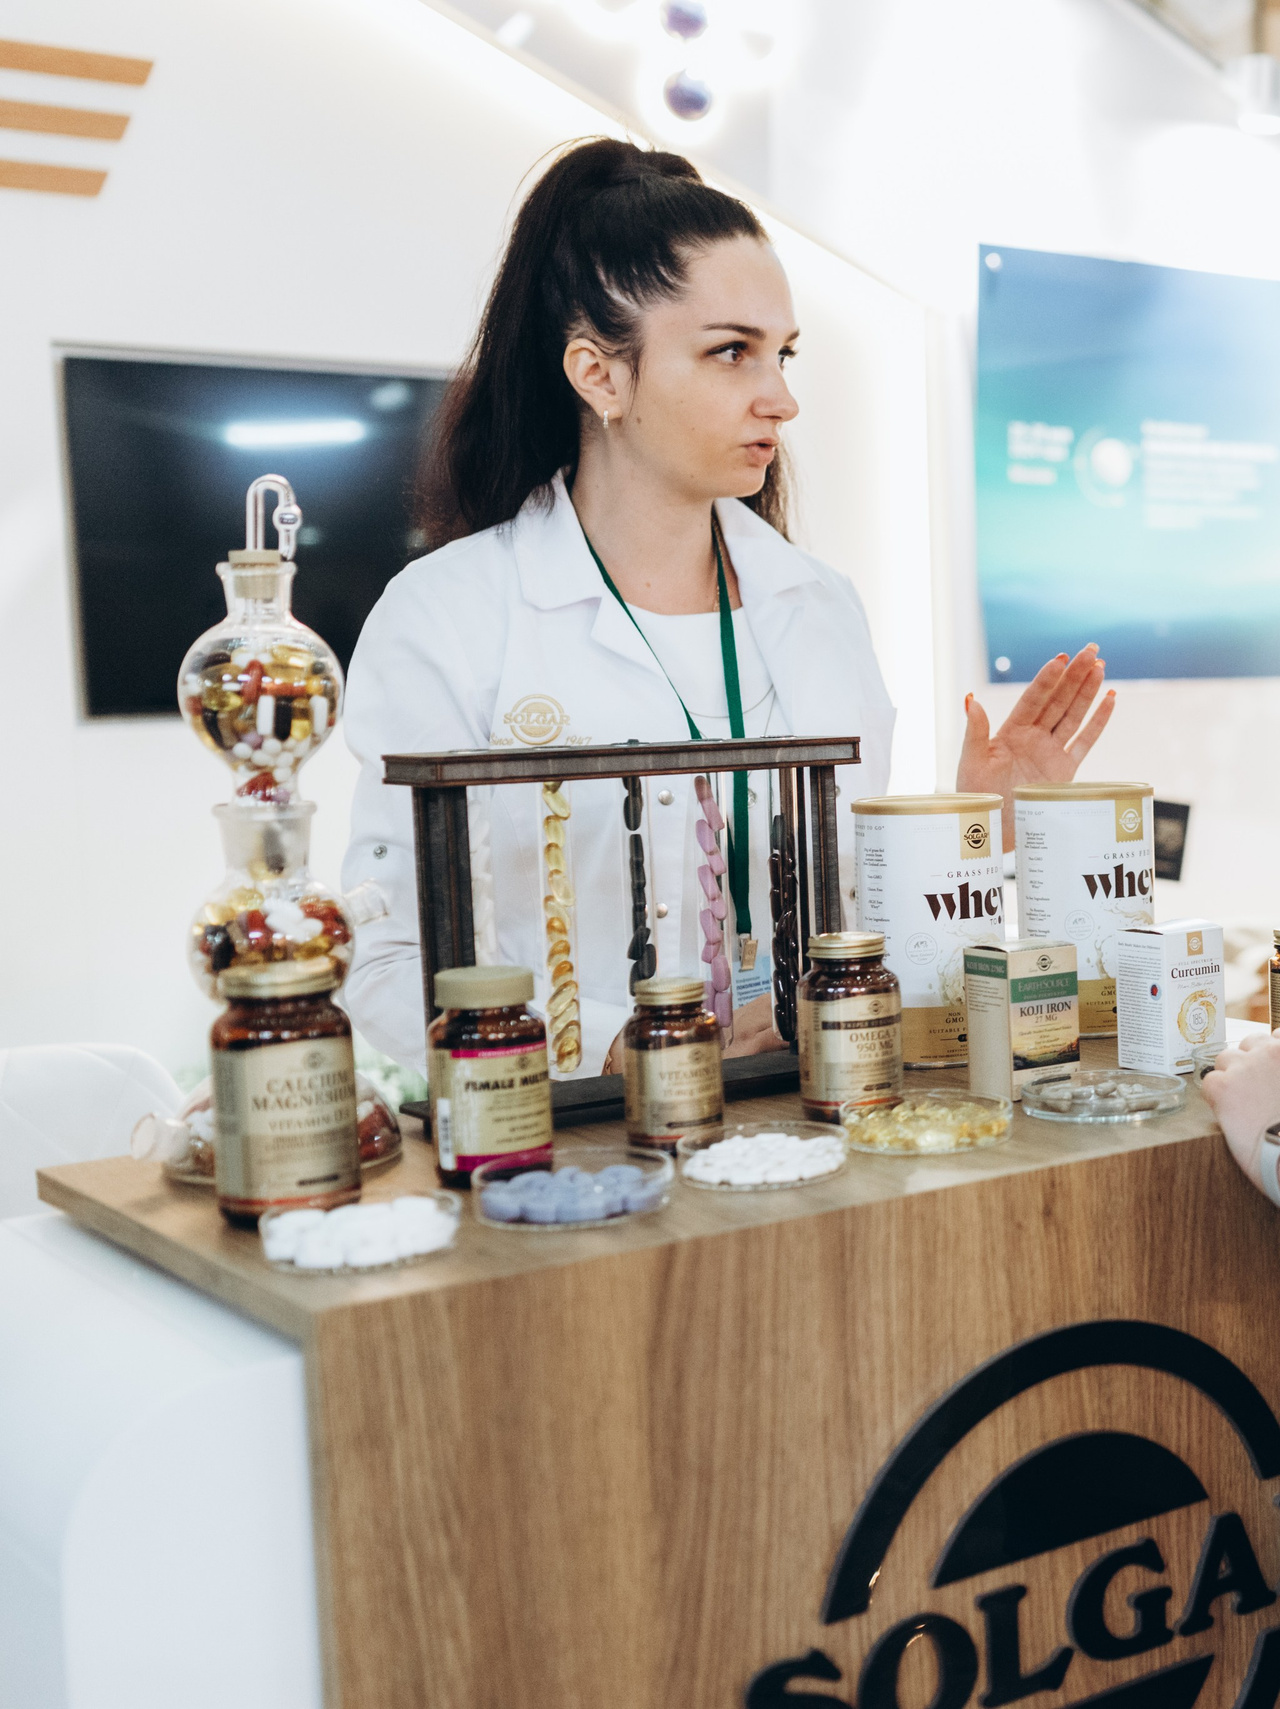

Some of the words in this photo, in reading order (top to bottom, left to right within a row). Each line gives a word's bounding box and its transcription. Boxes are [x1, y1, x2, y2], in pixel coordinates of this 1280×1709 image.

[504, 713, 571, 726] SOLGAR
[490, 732, 514, 747] Since
[564, 735, 592, 746] 1947
[963, 832, 988, 840] SOLGAR
[1104, 852, 1136, 860] GRASS
[947, 869, 982, 878] GRASS
[986, 866, 999, 875] FED
[1171, 963, 1220, 979] Curcumin
[1020, 1004, 1043, 1018] KOJI
[1046, 1001, 1072, 1014] IRON
[1045, 1014, 1057, 1022] MG
[849, 1028, 891, 1043] OMEGA
[856, 1042, 876, 1052] 950
[266, 1070, 349, 1094] CALCIUM
[465, 1078, 515, 1092] FEMALE
[252, 1084, 357, 1112] MAGNESIUM
[268, 1114, 331, 1131] VITAMIN
